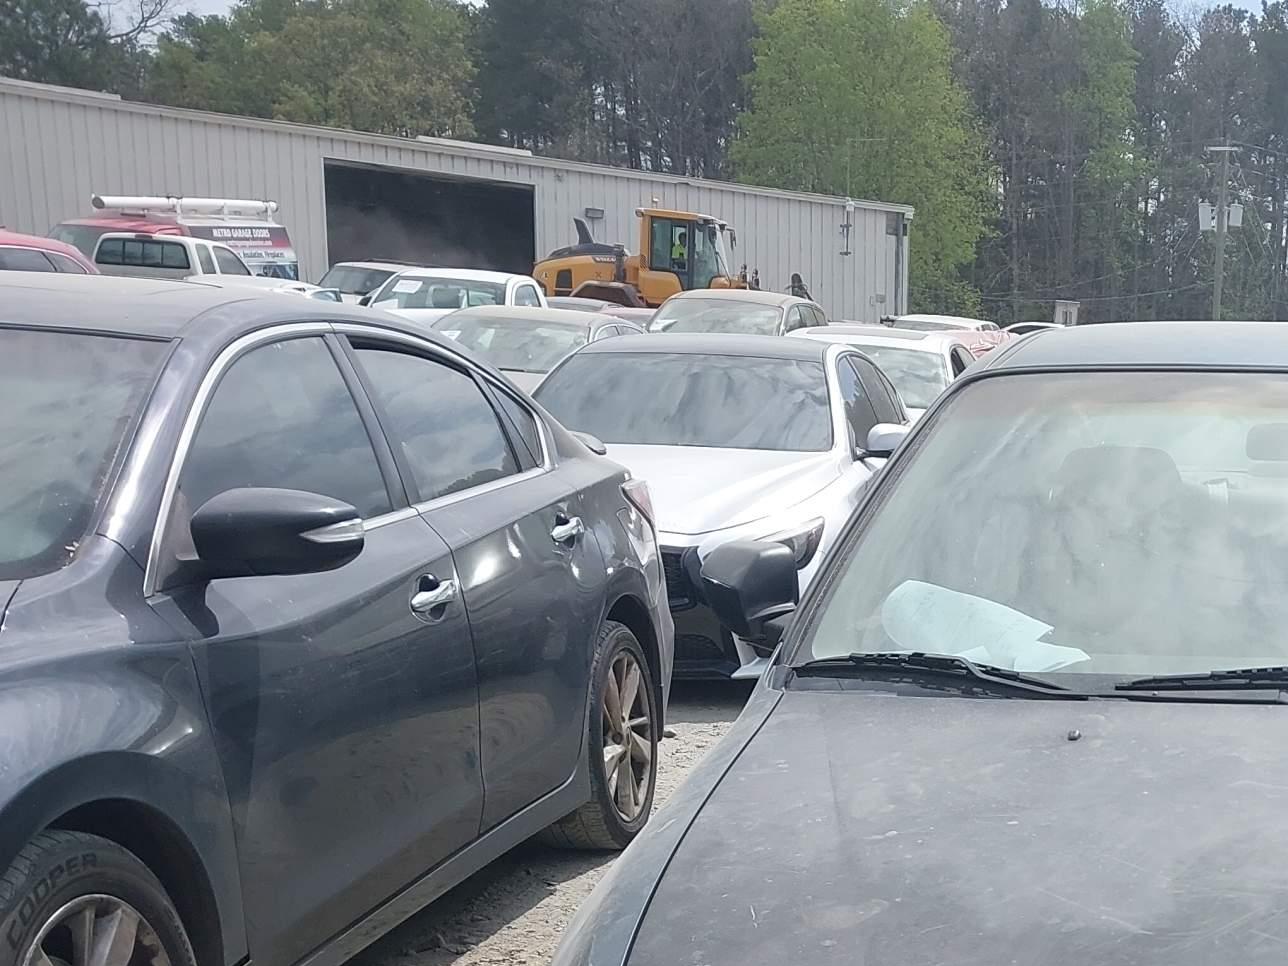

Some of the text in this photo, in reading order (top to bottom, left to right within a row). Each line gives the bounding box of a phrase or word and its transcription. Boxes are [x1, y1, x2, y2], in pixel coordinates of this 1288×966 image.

[212, 229, 270, 239] METRO GARAGE DOORS
[6, 852, 97, 950] COOPER
